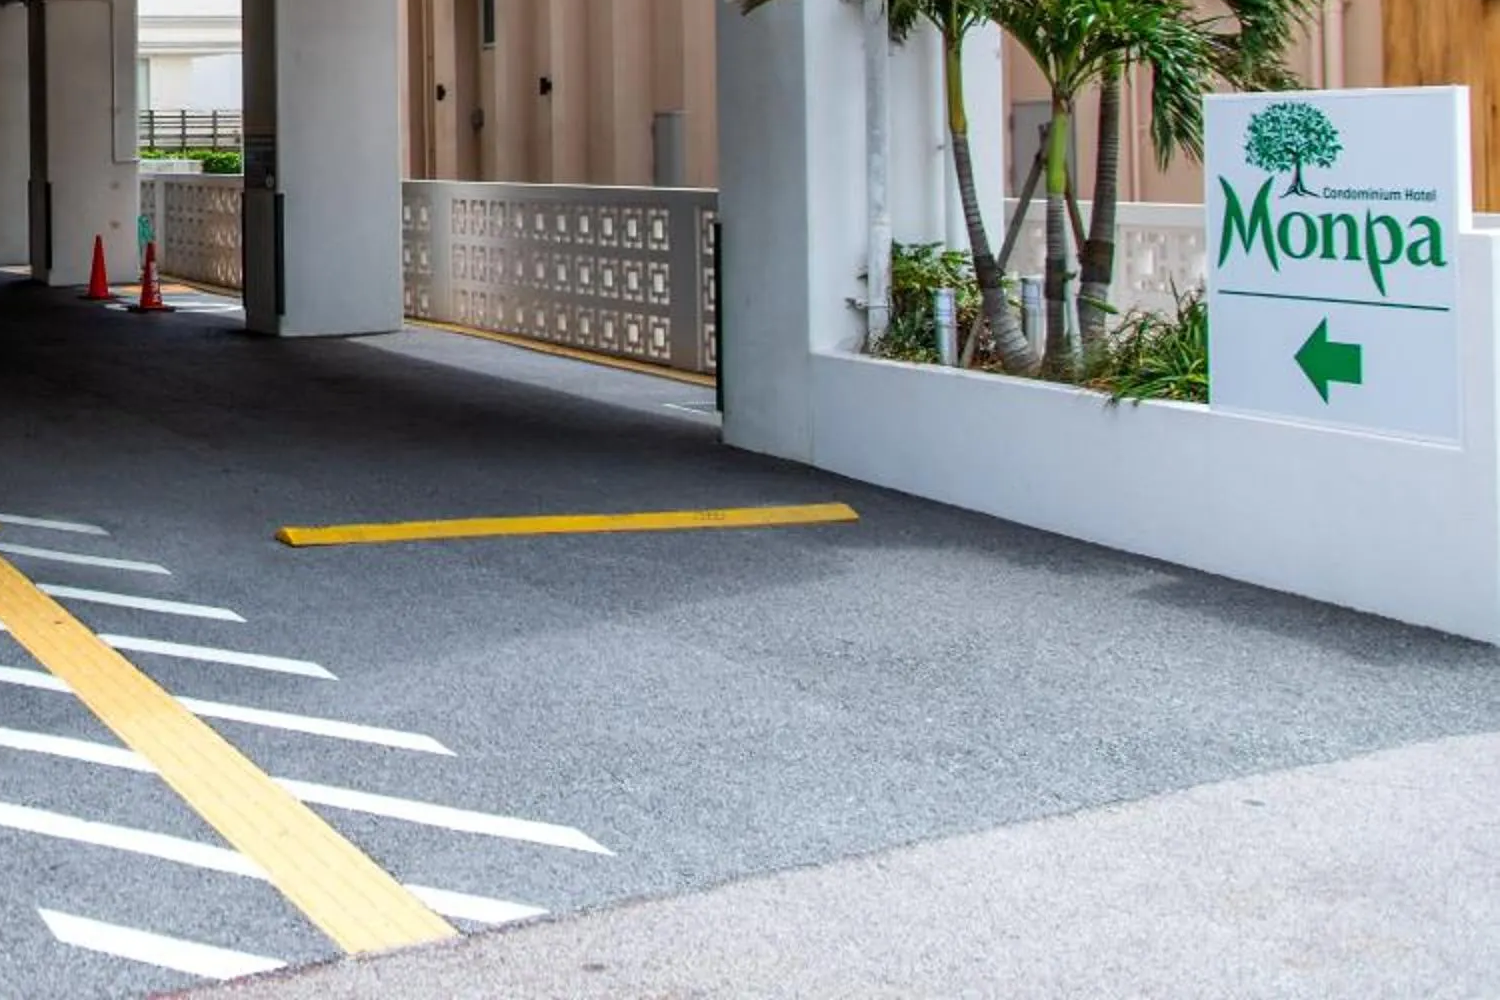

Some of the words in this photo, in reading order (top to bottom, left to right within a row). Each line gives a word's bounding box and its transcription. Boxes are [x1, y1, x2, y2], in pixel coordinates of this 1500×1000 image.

[1322, 187, 1402, 201] Condominium
[1404, 189, 1437, 202] Hotel
[1217, 174, 1448, 297] Monpa
